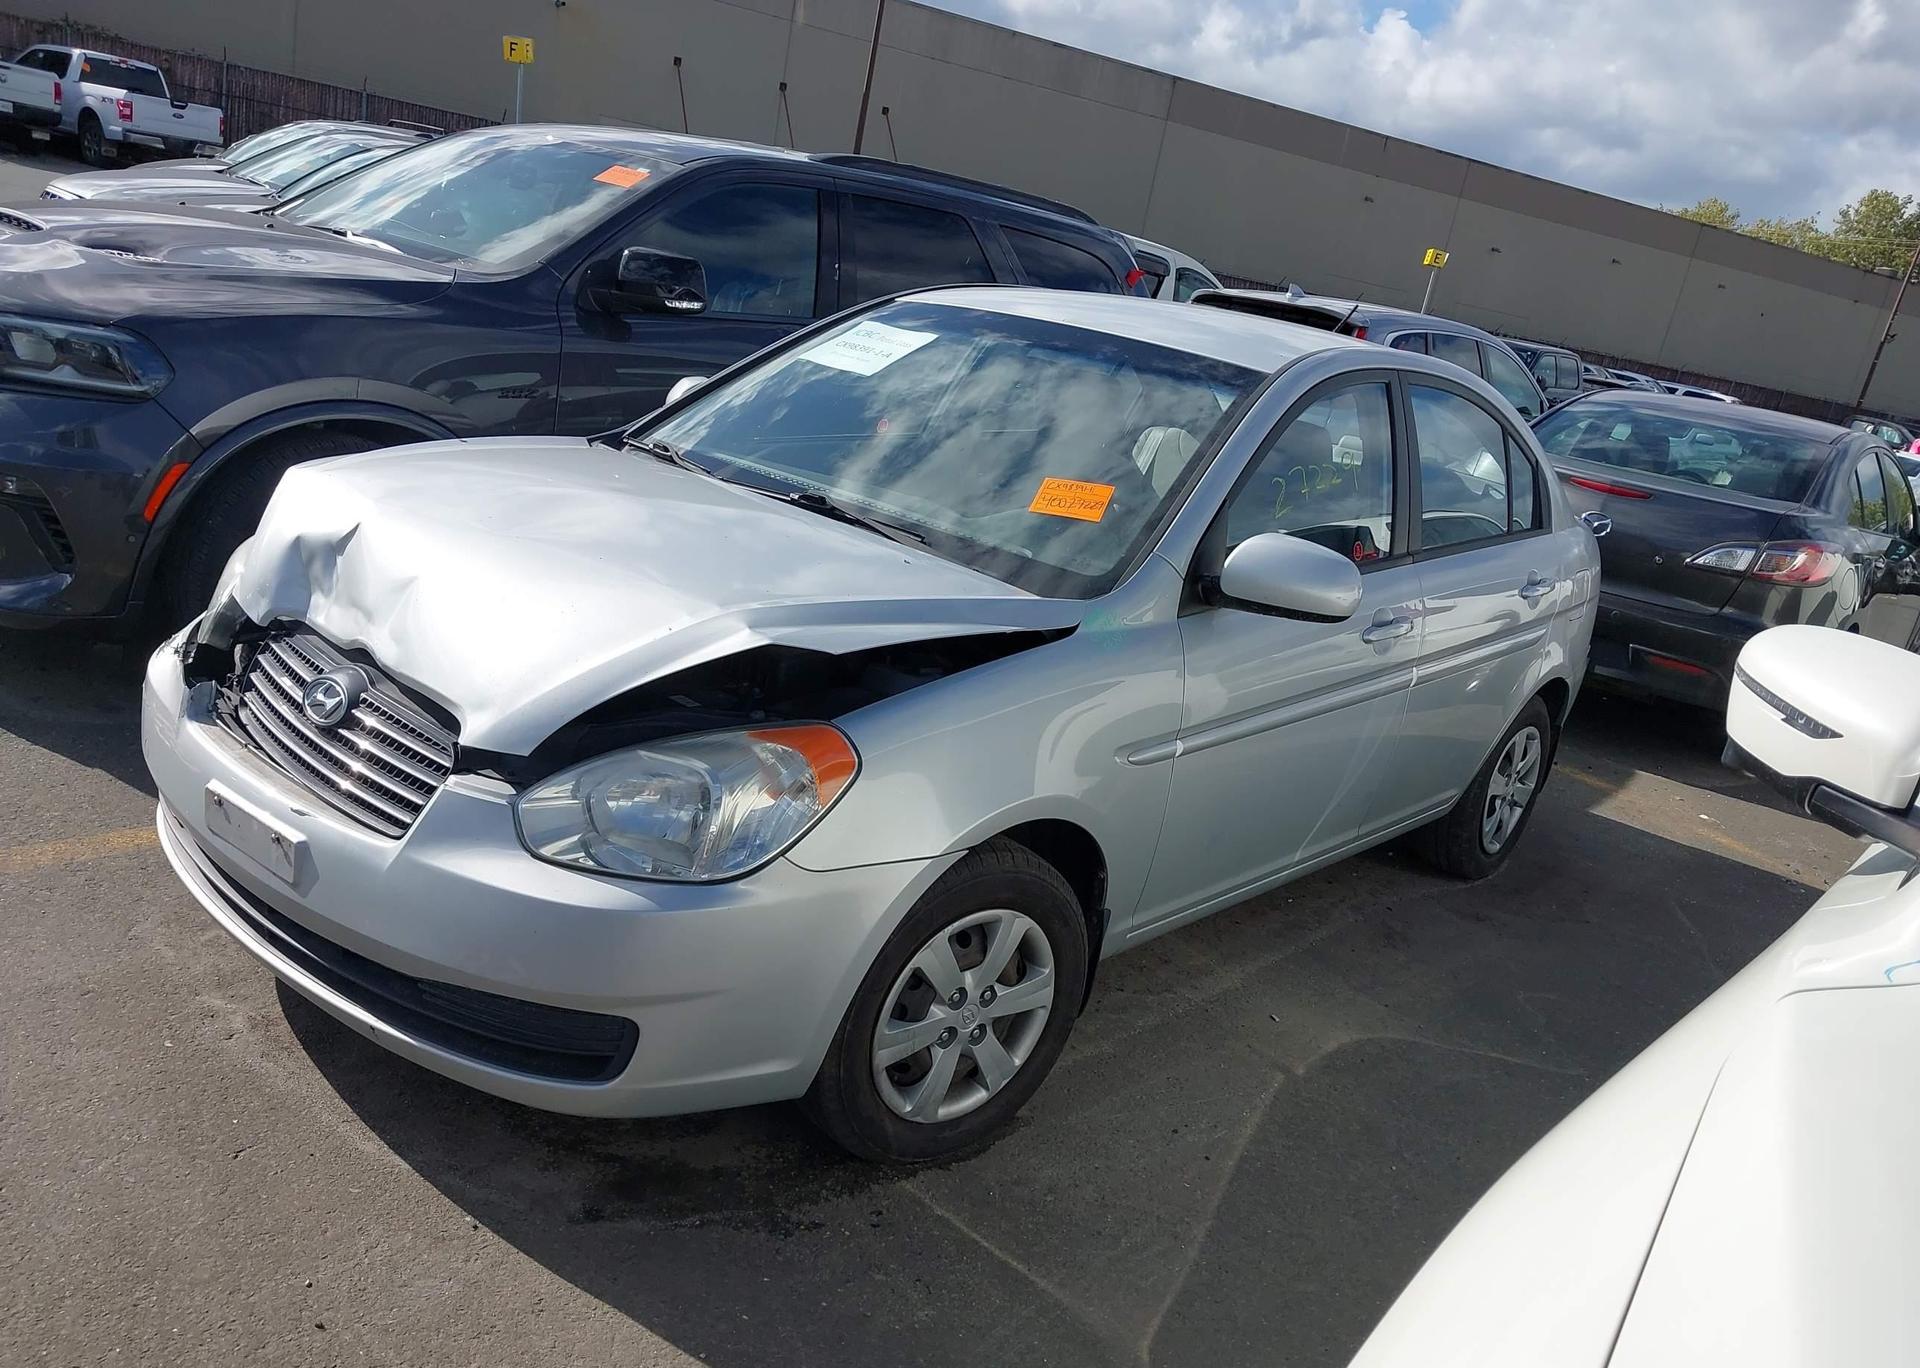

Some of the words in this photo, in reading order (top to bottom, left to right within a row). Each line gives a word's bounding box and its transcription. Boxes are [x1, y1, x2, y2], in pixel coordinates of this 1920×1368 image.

[509, 41, 519, 58] F
[1433, 252, 1443, 265] E
[1271, 451, 1359, 519] 27229
